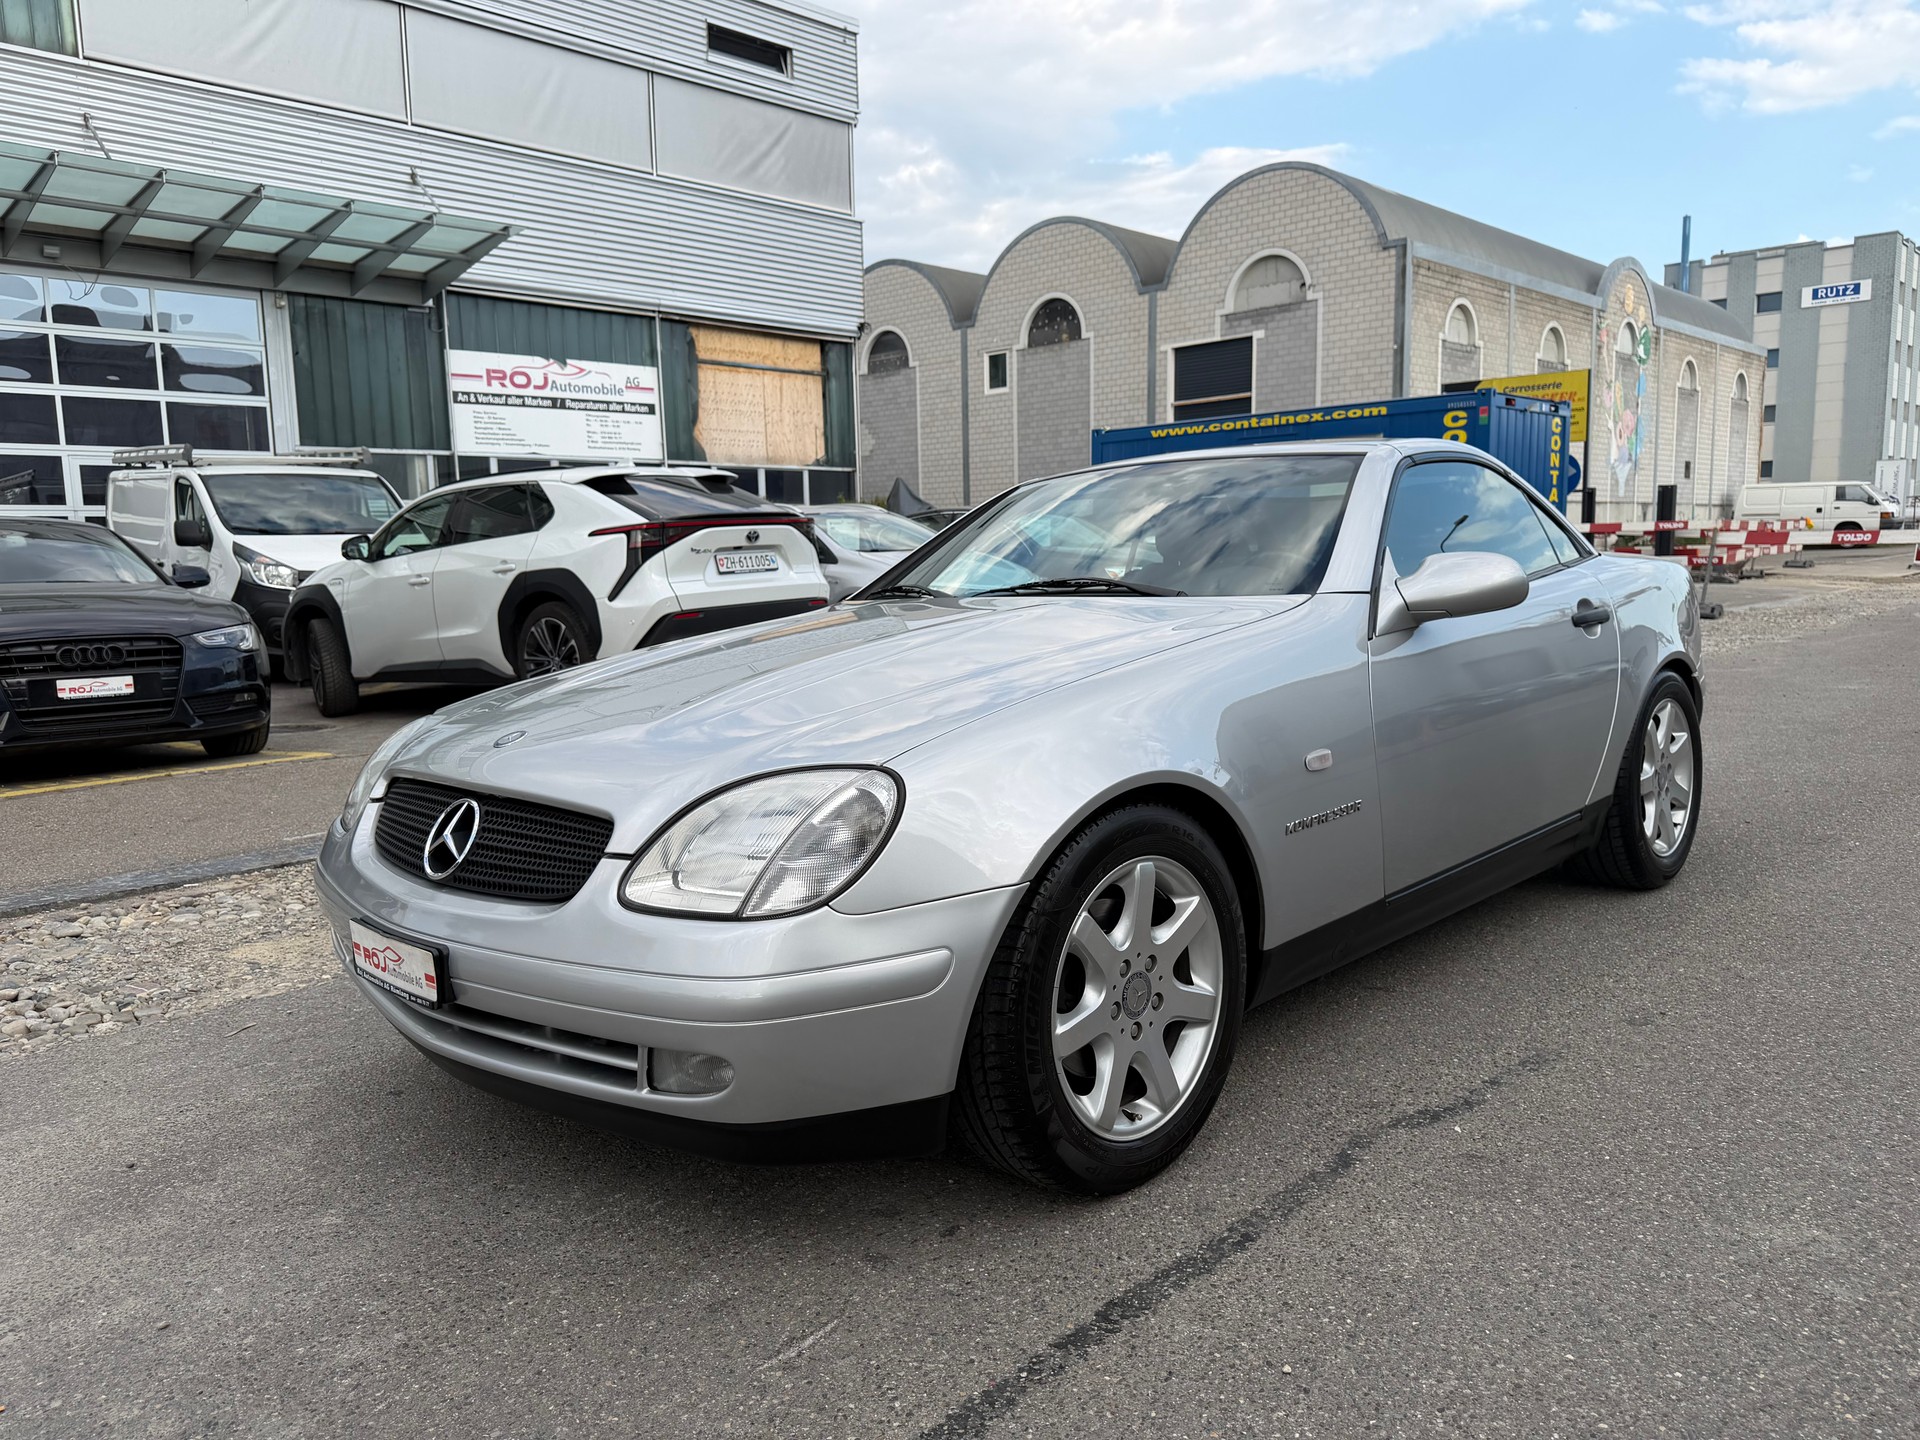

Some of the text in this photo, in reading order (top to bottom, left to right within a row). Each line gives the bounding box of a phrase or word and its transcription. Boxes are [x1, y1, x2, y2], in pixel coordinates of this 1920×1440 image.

[1818, 284, 1855, 299] RUTZ
[486, 368, 640, 397] ROJ Automobile AG
[1503, 381, 1562, 394] Carrosserie
[457, 393, 468, 402] An
[470, 393, 476, 402] &
[476, 394, 506, 404] Verkauf
[507, 396, 523, 405] aller
[524, 397, 552, 407] Marken
[565, 399, 608, 411] Reparaturen
[609, 402, 623, 411] aller
[624, 403, 649, 413] Marken
[1150, 406, 1387, 438] www.containex.com
[1549, 417, 1562, 503] CONTA
[1837, 533, 1872, 542] TOLDO
[69, 686, 92, 694] ROJ
[1285, 799, 1362, 836] KOMPRESSOR
[362, 946, 387, 973] ROJ
[387, 964, 415, 986] Automobile
